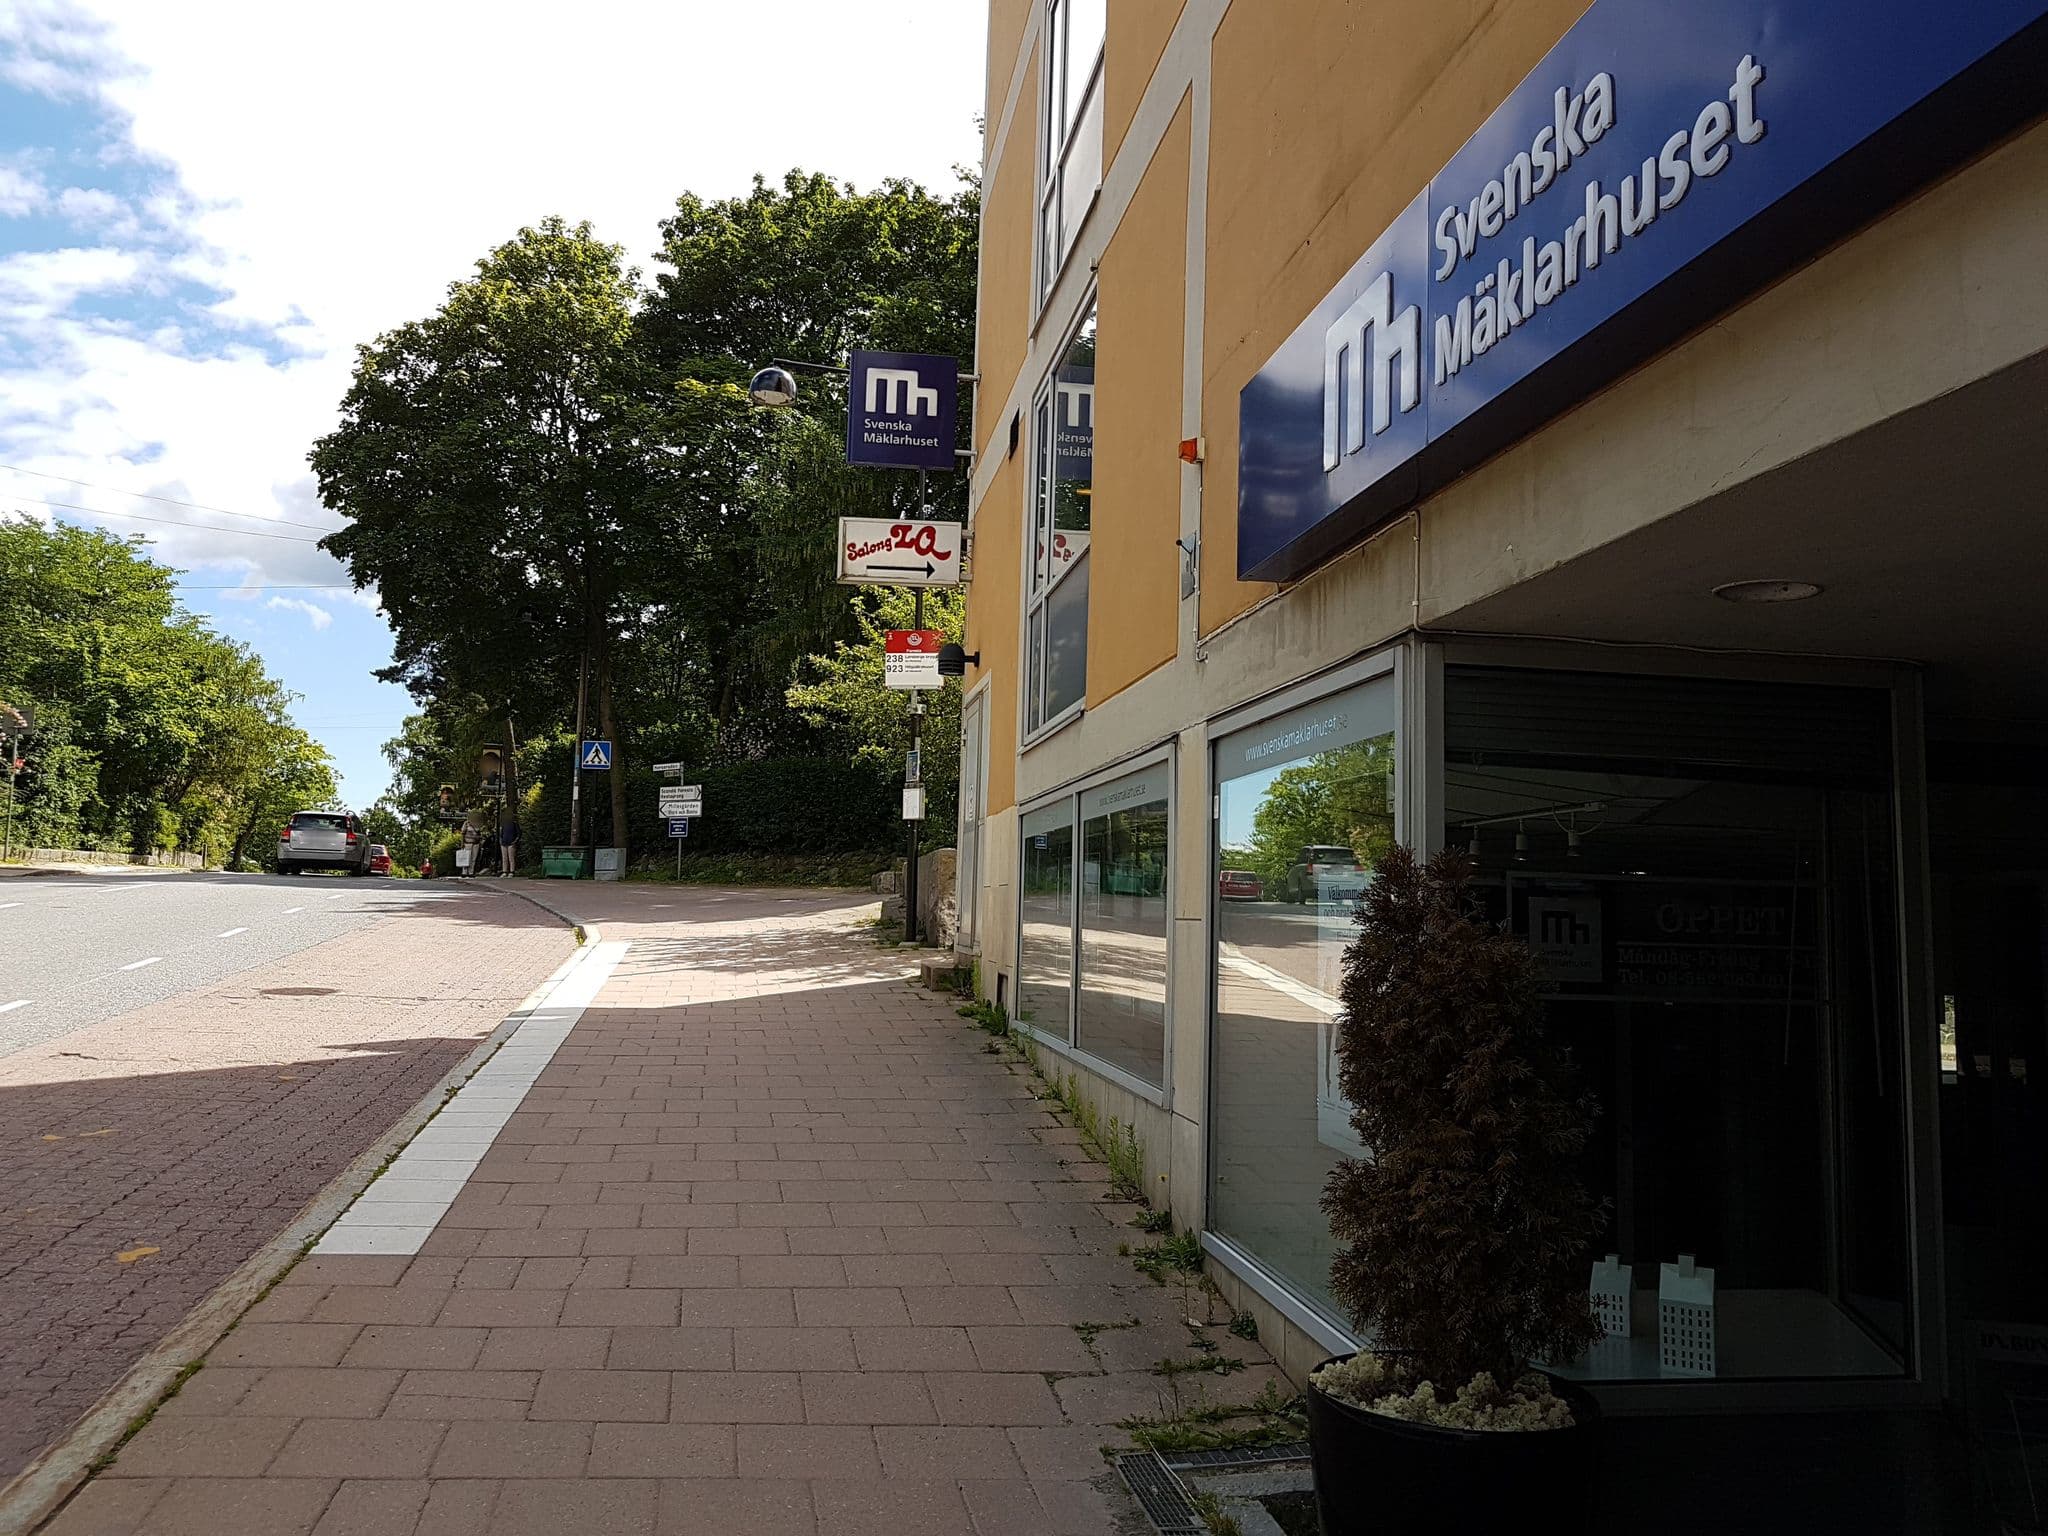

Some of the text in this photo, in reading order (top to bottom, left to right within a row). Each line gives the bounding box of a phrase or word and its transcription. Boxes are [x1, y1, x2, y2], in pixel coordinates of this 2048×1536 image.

[1434, 71, 1616, 283] Svenska
[1432, 54, 1767, 387] Mäklarhuset
[864, 418, 912, 432] Svenska
[863, 432, 939, 447] Mäklarhuset
[847, 537, 892, 561] Salong
[886, 654, 904, 662] 238
[886, 665, 904, 673] 923
